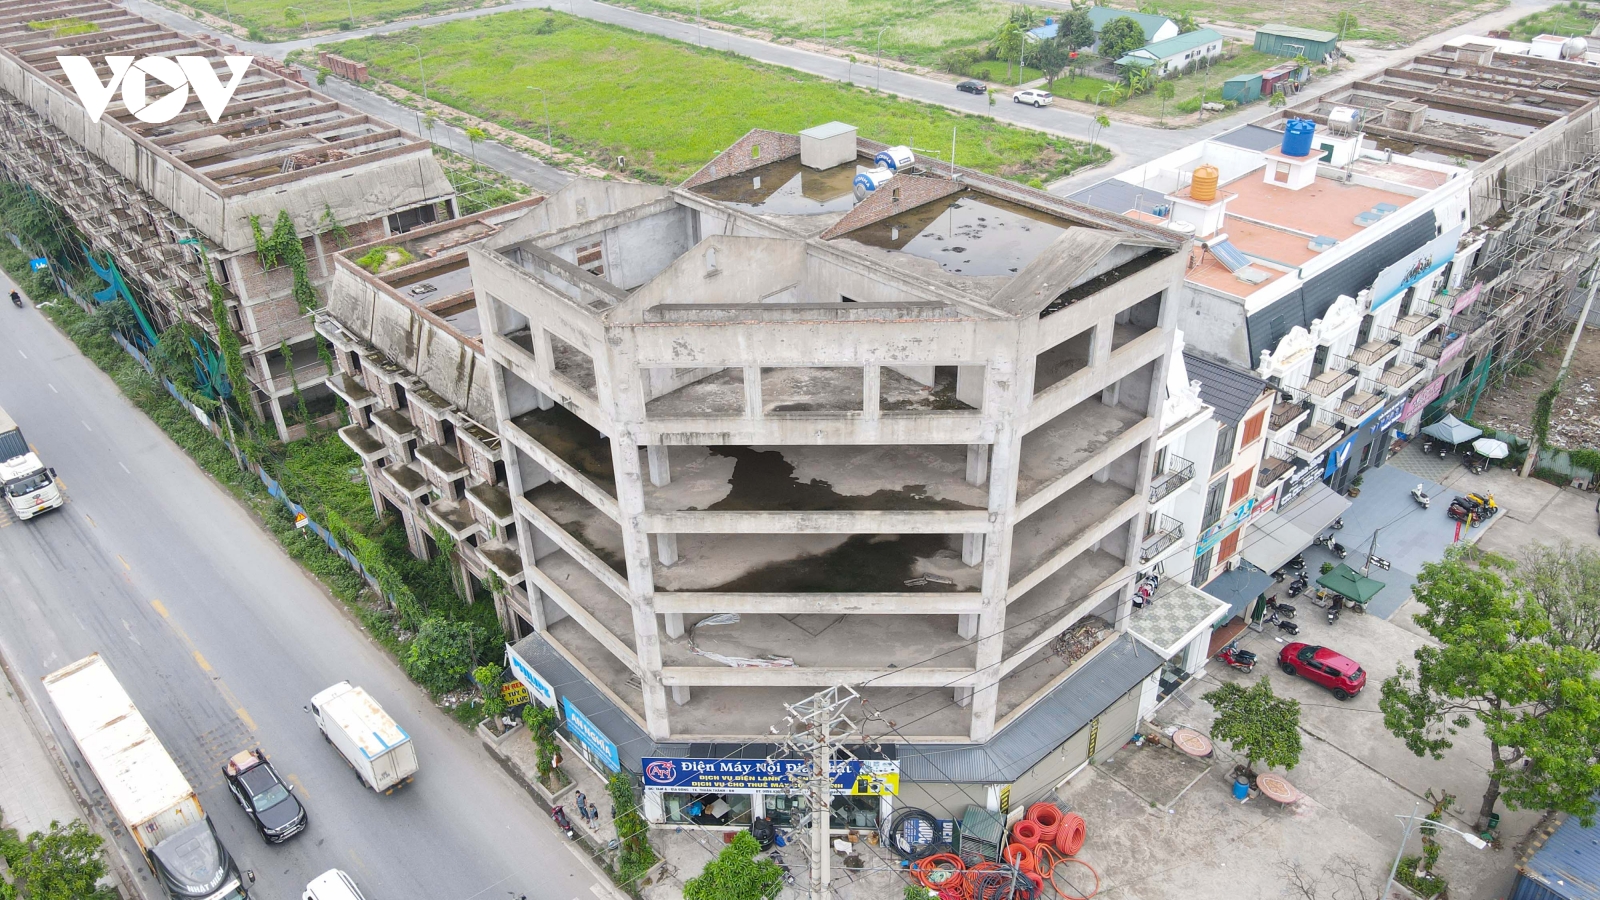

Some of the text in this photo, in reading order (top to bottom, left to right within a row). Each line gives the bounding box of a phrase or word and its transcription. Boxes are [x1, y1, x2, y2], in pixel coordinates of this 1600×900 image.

[681, 761, 716, 773] Điện
[720, 762, 751, 774] Máy
[756, 762, 781, 775] Nội
